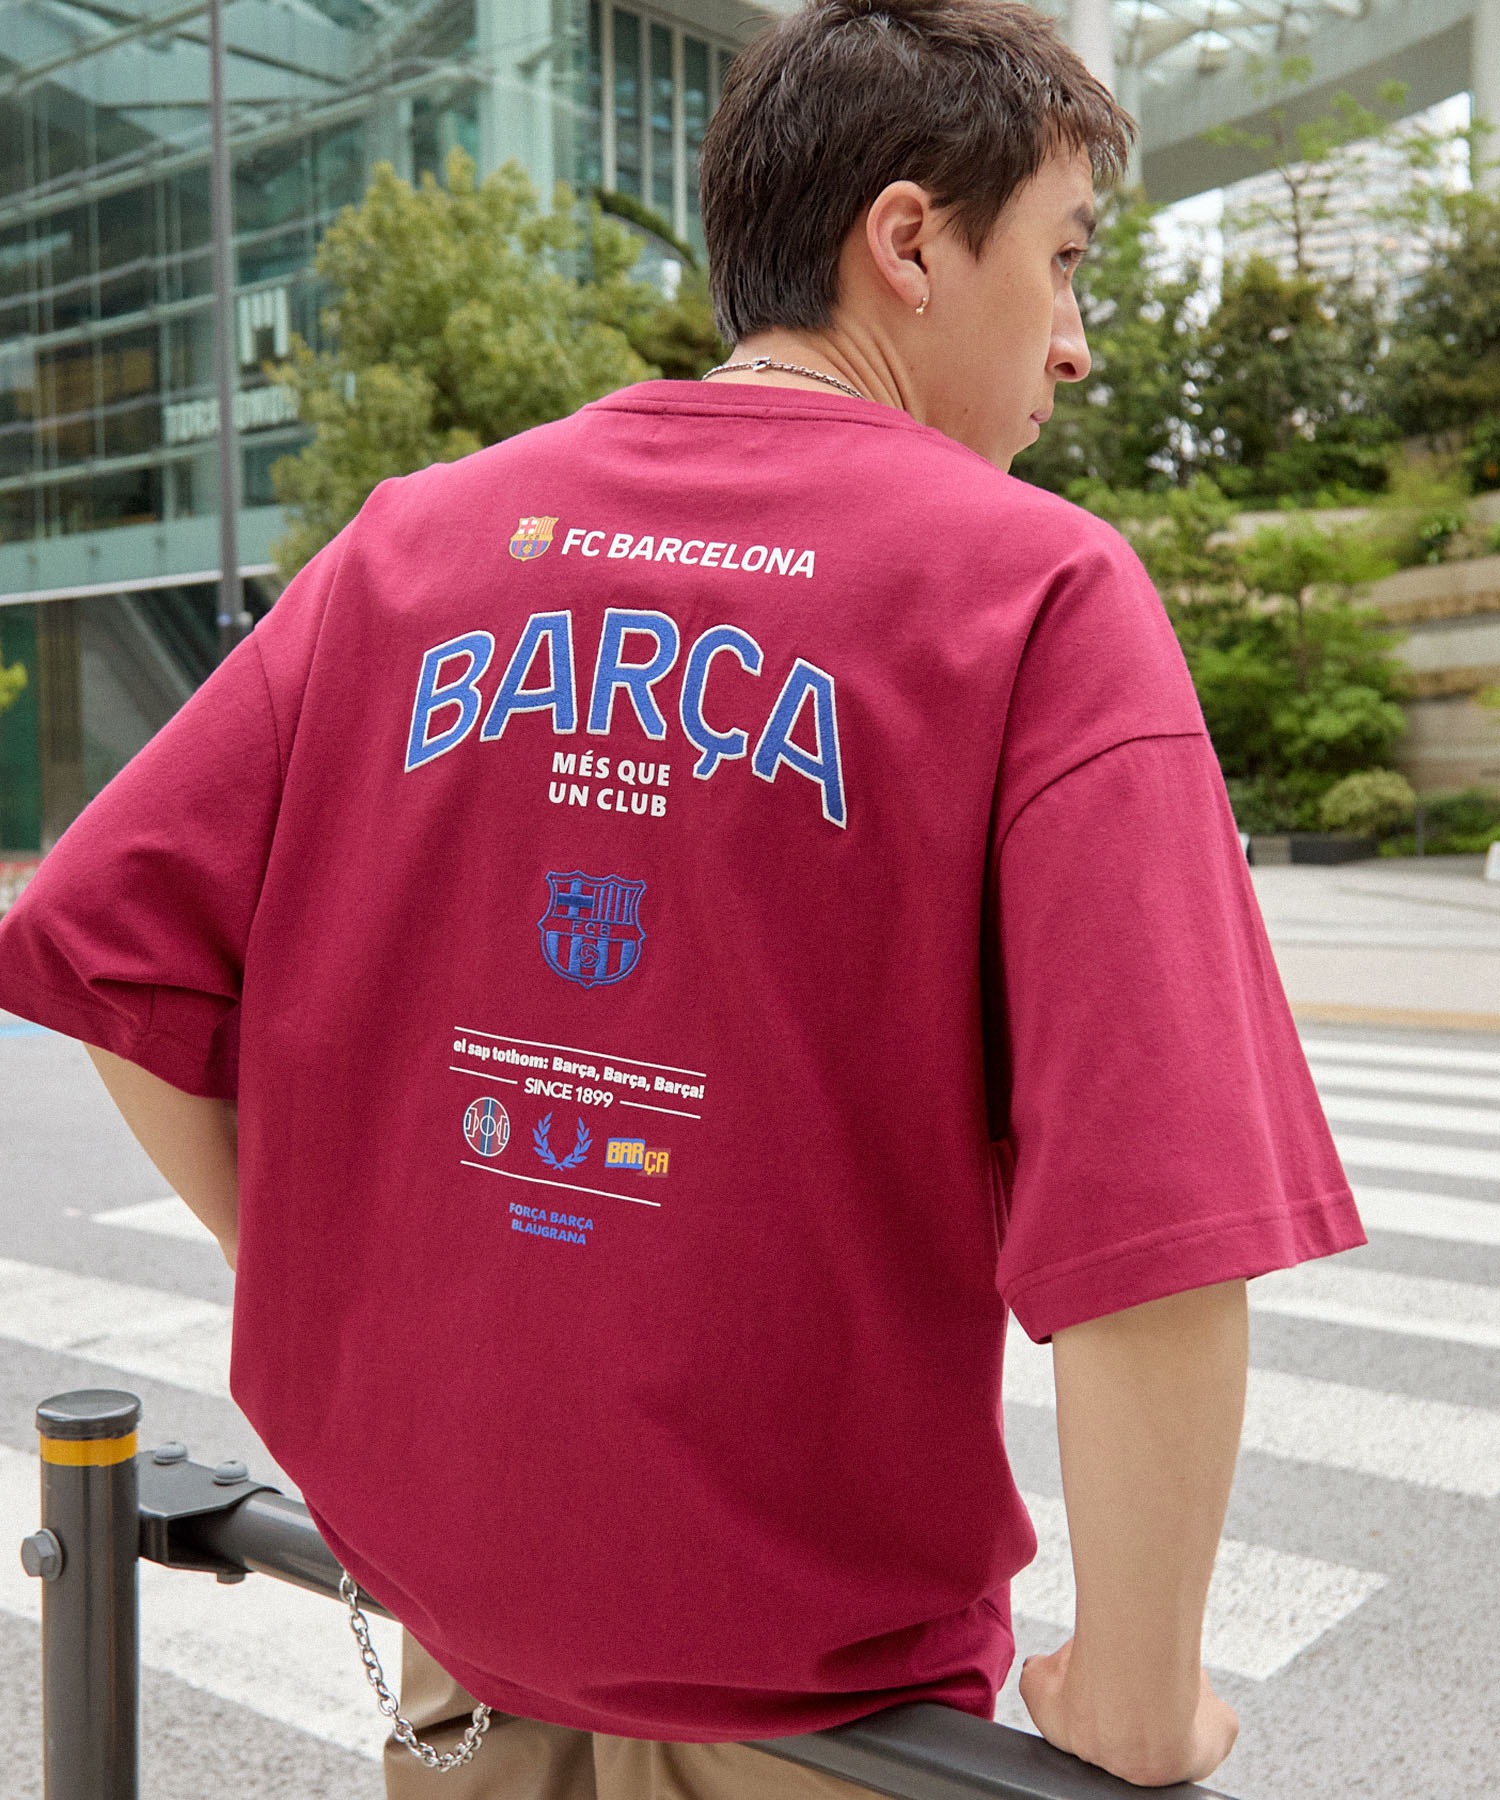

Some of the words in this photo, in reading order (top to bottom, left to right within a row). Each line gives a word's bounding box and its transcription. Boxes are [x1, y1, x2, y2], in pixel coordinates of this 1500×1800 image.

[561, 528, 605, 557] FC
[607, 533, 815, 578] BARCELONA
[404, 607, 847, 830] BARÇA
[552, 749, 610, 779] MÉS
[617, 759, 670, 787] QUE
[548, 781, 589, 807] UN
[597, 788, 667, 817] CLUB
[453, 1038, 466, 1053] el
[468, 1043, 490, 1060] sap
[492, 1046, 549, 1069] tothom:
[552, 1056, 600, 1081] Barça,
[603, 1066, 650, 1092] Barça,
[654, 1076, 705, 1099] Barça!
[524, 1077, 573, 1100] SINCE
[575, 1086, 614, 1108] 1899
[509, 1202, 547, 1222] FORÇA
[550, 1212, 594, 1231] BARÇA
[511, 1218, 586, 1245] BLAUGRANA
